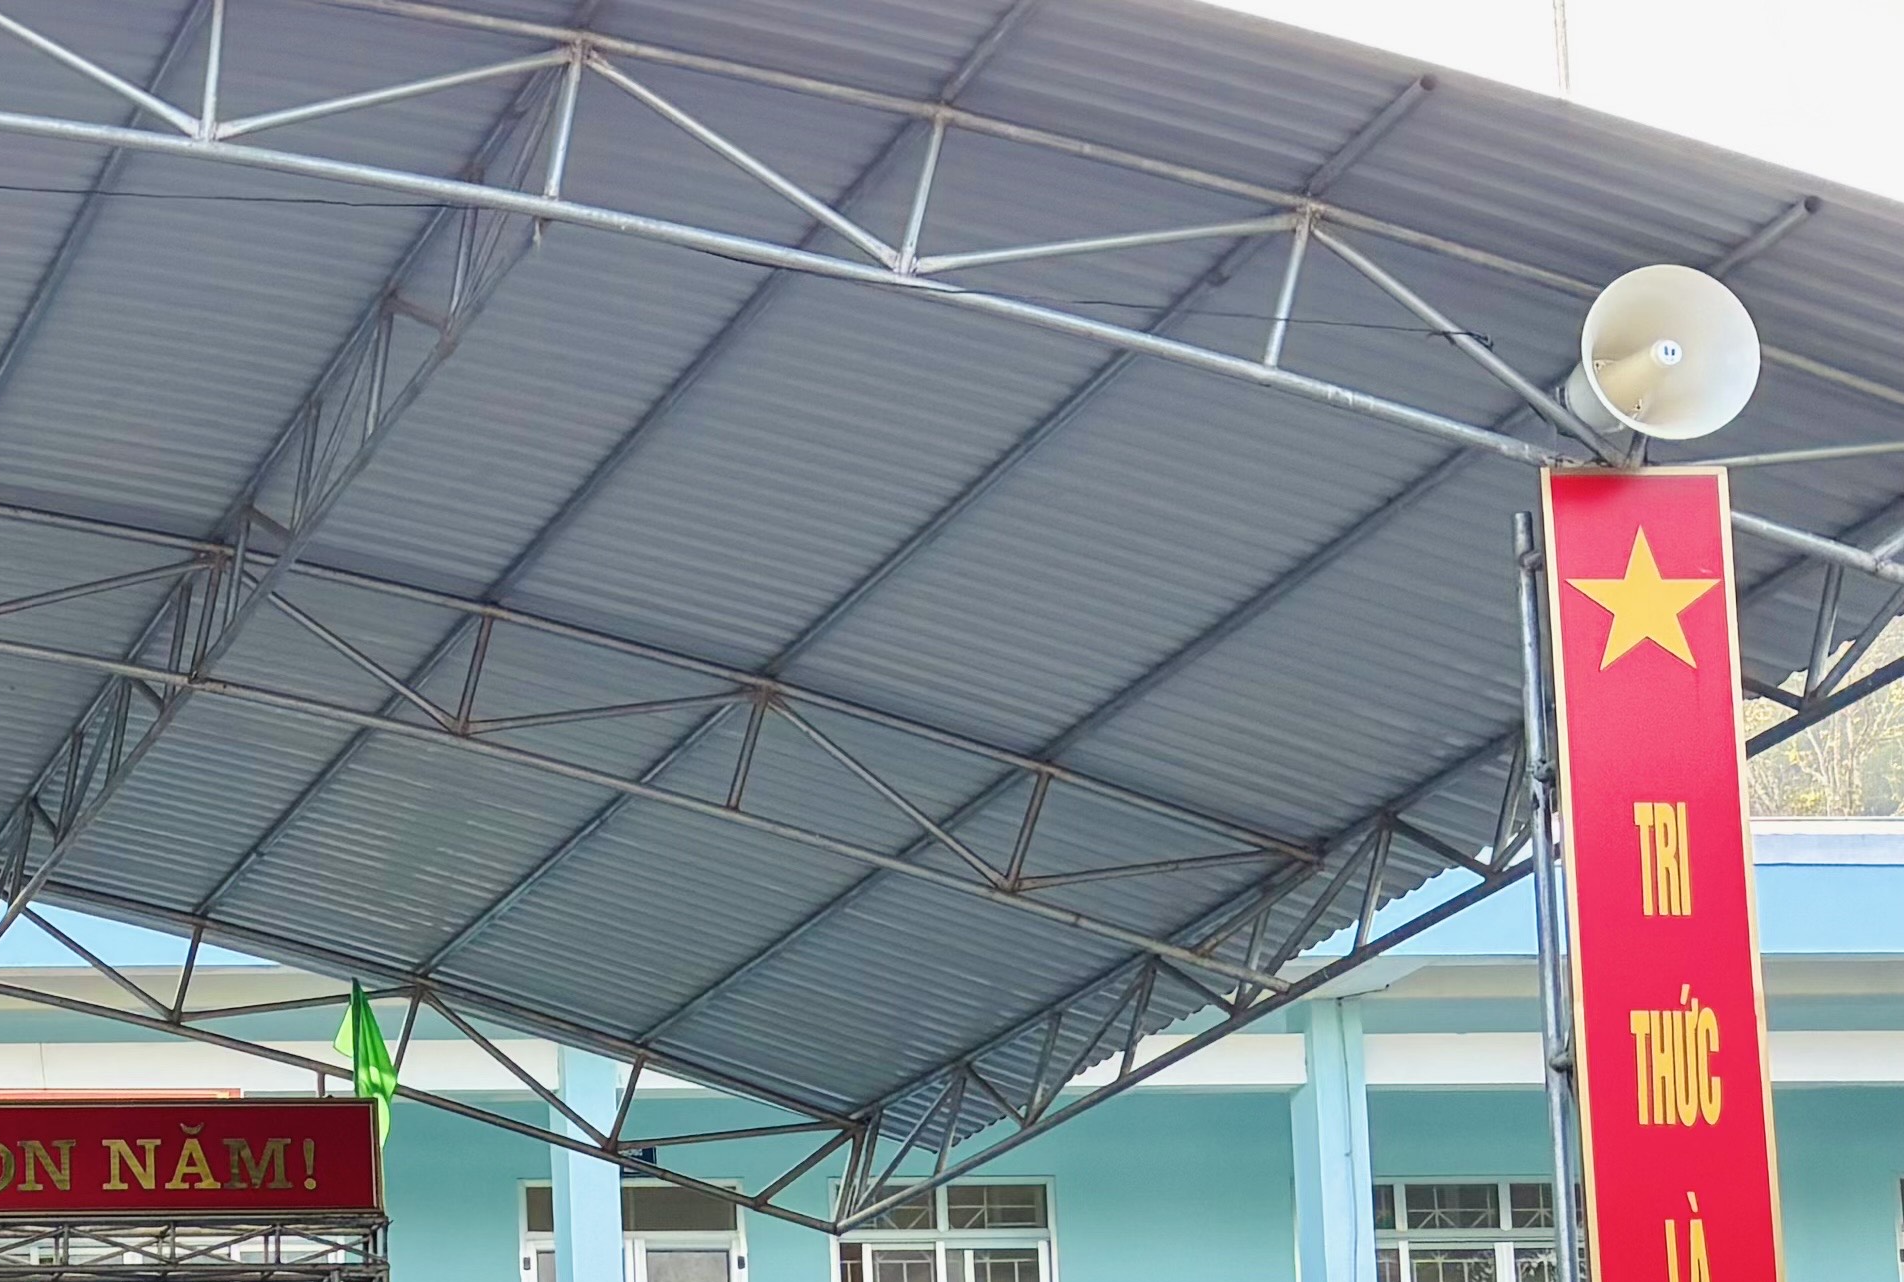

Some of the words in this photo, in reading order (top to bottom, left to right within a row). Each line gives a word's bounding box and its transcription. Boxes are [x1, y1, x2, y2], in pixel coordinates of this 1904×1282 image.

[1633, 801, 1693, 917] TRI
[1629, 984, 1723, 1127] THỨC
[102, 1121, 317, 1192] NĂM!
